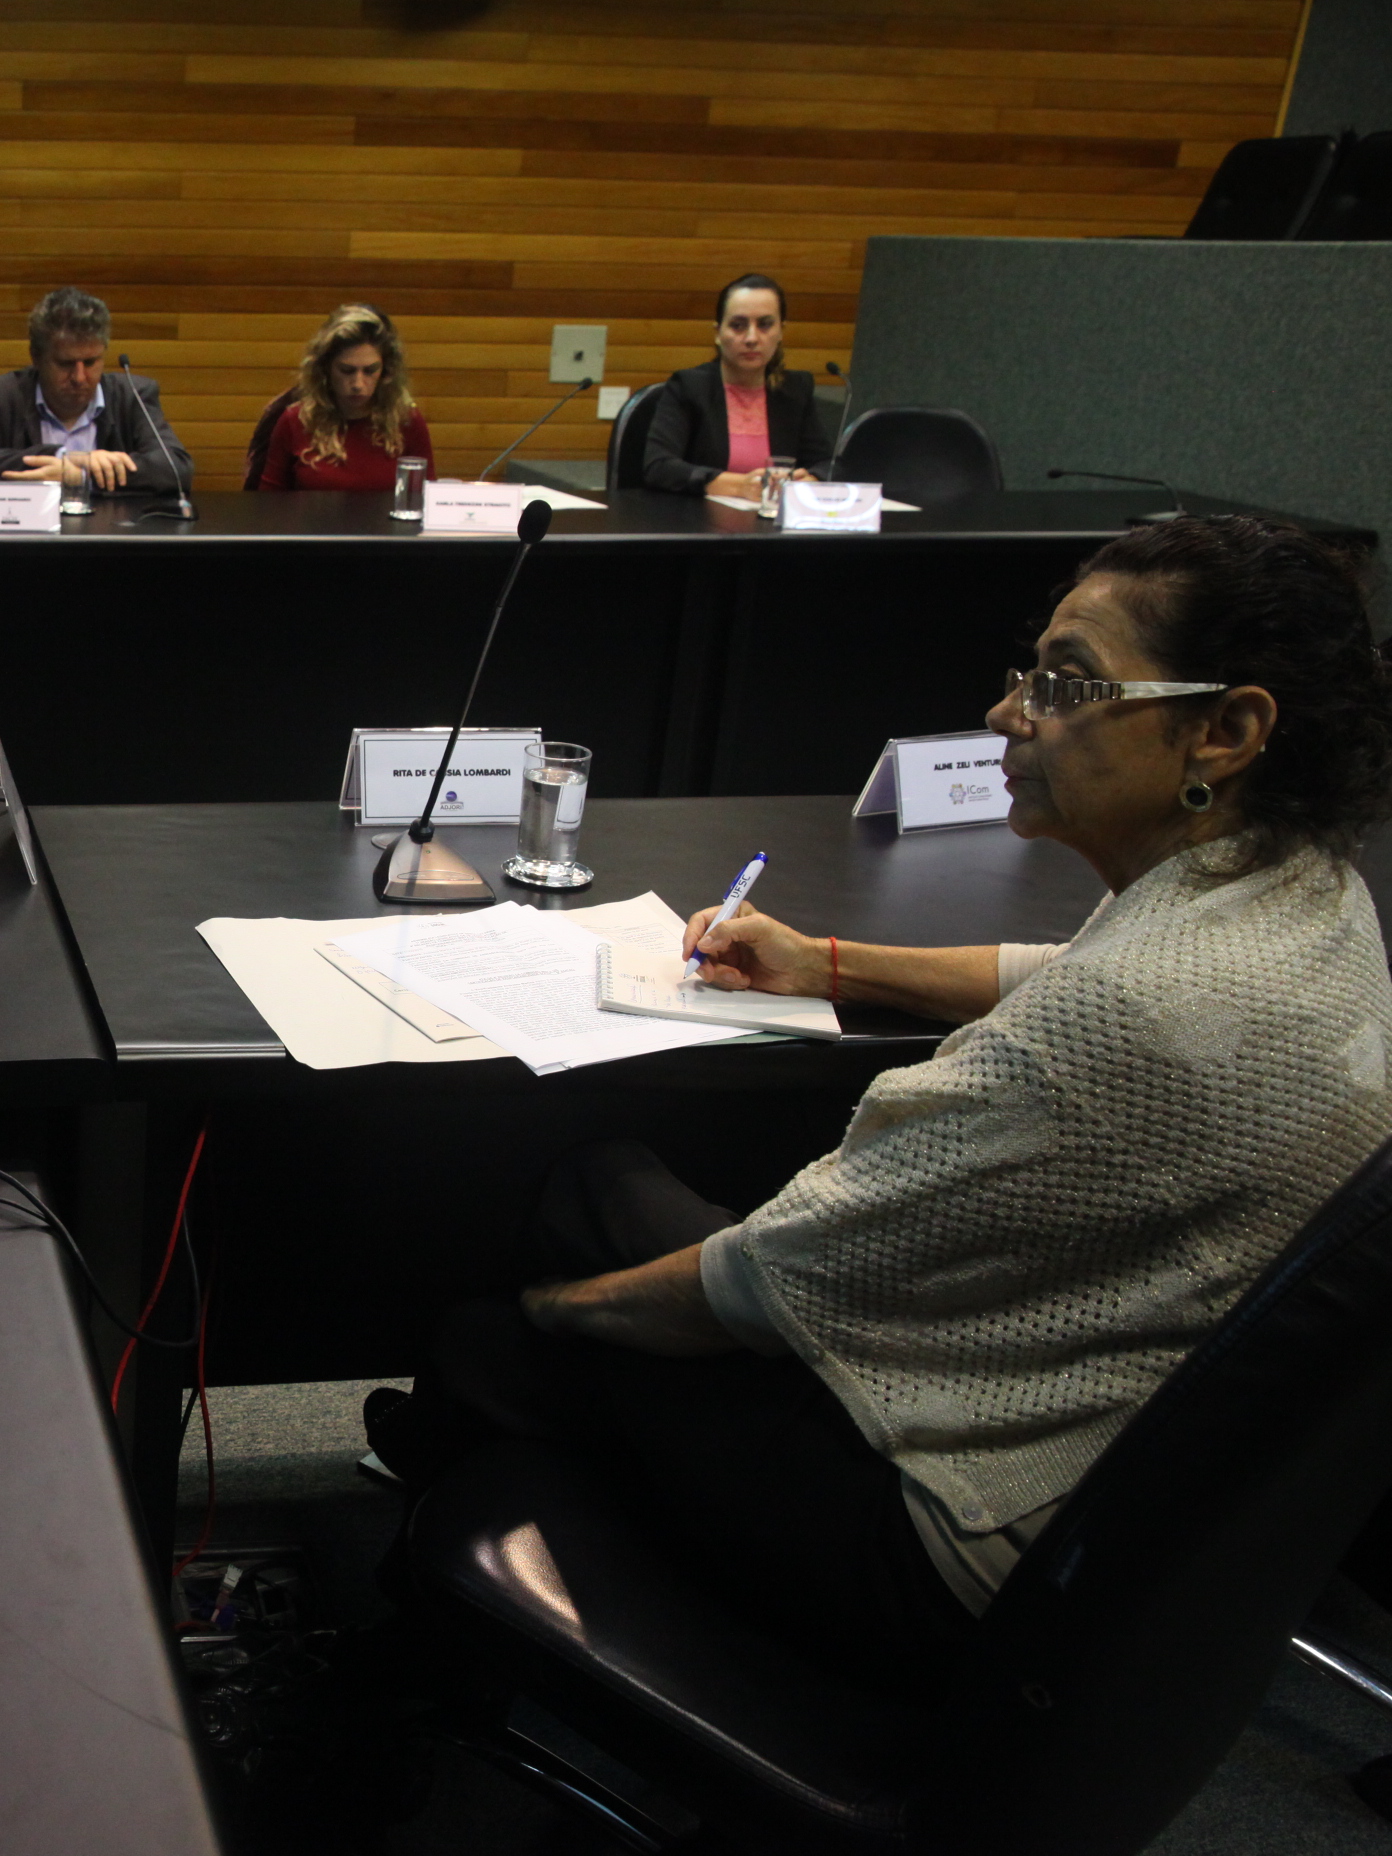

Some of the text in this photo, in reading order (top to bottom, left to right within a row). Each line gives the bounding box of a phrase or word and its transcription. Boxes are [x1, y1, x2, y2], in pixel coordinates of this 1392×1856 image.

[934, 762, 953, 771] ALINE
[393, 768, 511, 777] RITA DE CSIA LOMBARDI
[730, 874, 751, 899] UFSC
